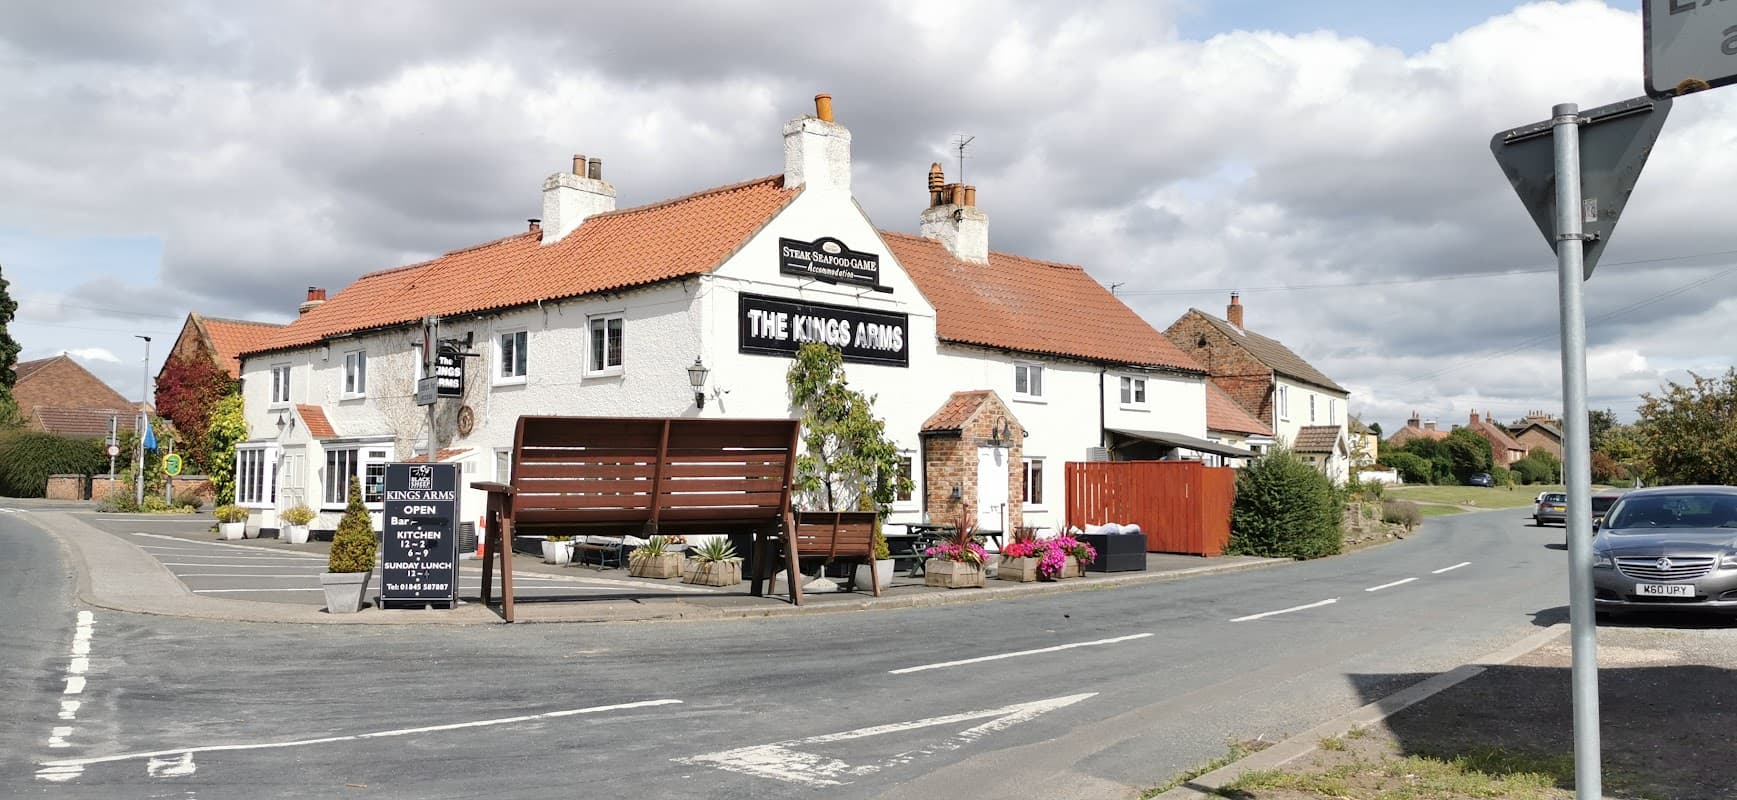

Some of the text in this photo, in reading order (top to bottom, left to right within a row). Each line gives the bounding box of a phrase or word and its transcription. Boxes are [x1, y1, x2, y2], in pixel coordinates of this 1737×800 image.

[807, 261, 854, 278] Accommodation
[747, 308, 904, 352] THE KINGS ARMS
[439, 356, 454, 365] The
[438, 378, 459, 388] RMS
[387, 491, 455, 500] KINGS ARMS
[404, 505, 436, 514] OPEN
[397, 531, 441, 539] KITCHEN
[1666, 585, 1687, 594] UPY
